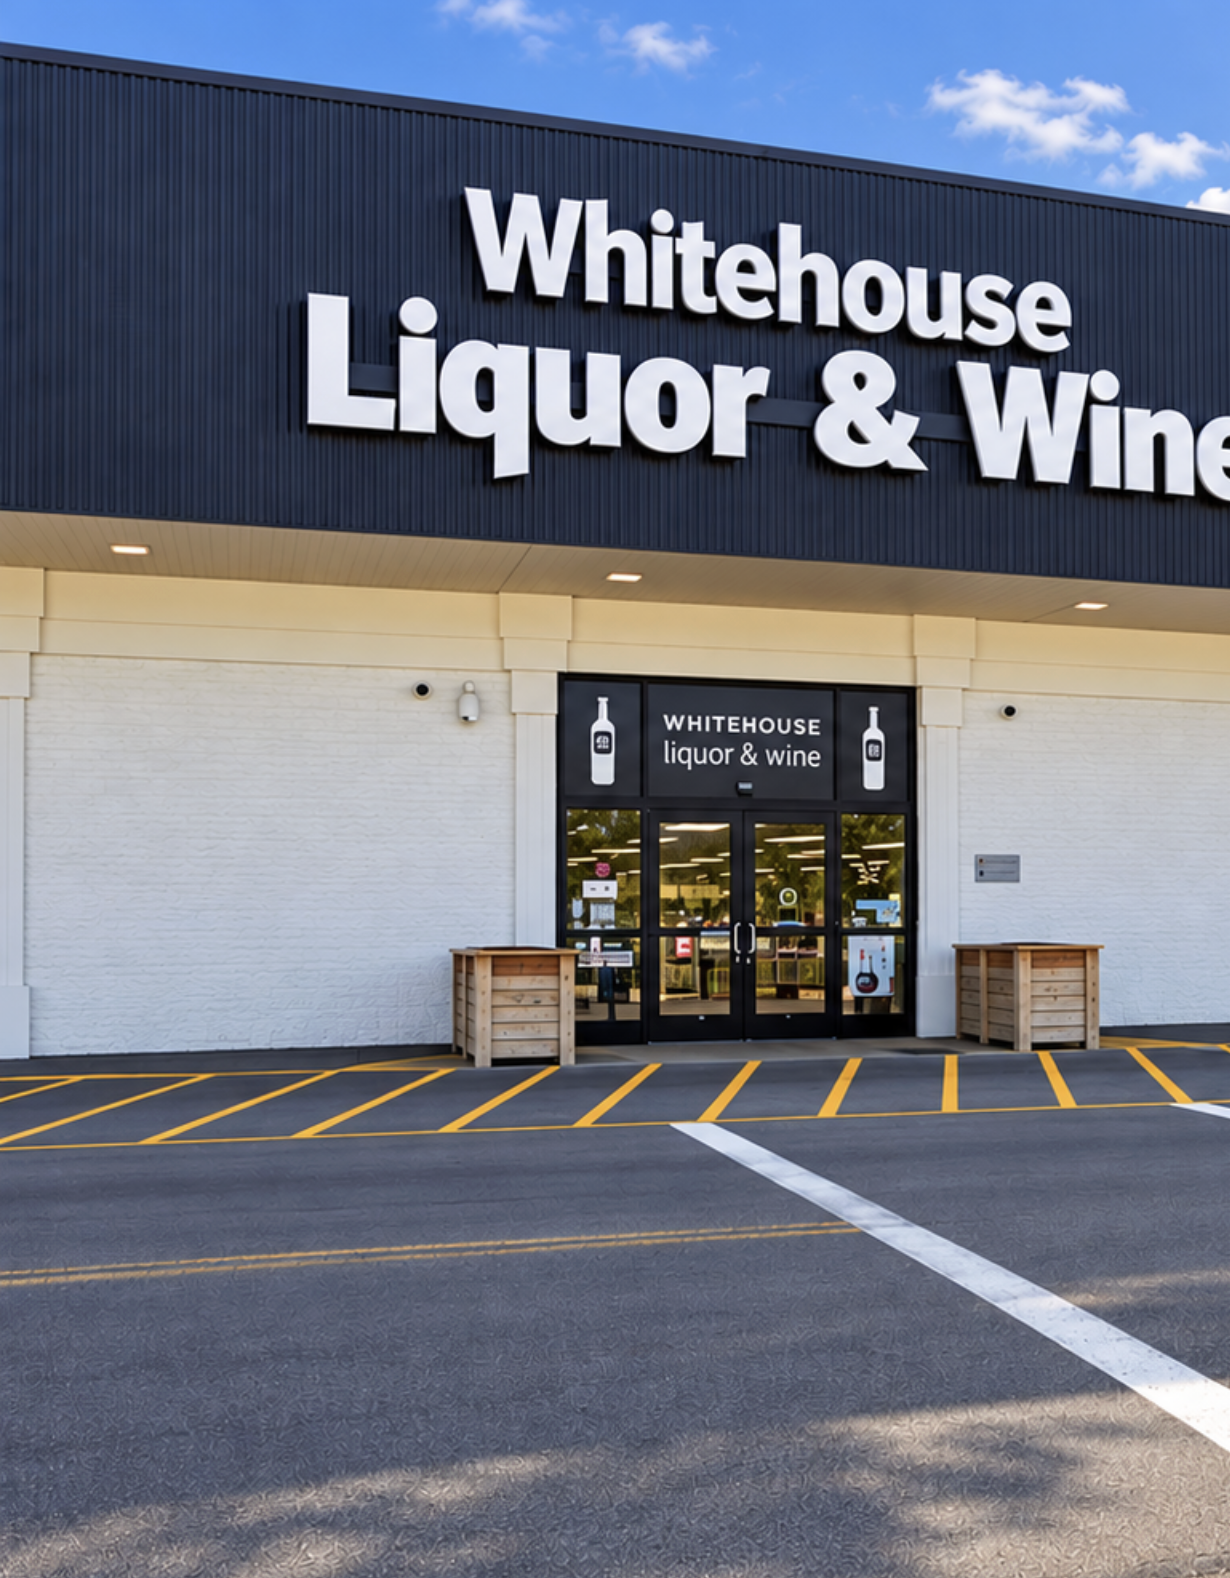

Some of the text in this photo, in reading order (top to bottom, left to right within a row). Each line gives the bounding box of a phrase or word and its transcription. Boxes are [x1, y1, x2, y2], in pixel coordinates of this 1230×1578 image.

[463, 187, 1072, 353] Whitehouse
[307, 292, 771, 479] Liquor
[814, 349, 929, 471] &
[663, 714, 821, 736] WHITEHOUSE
[664, 739, 821, 771] liquor & wine
